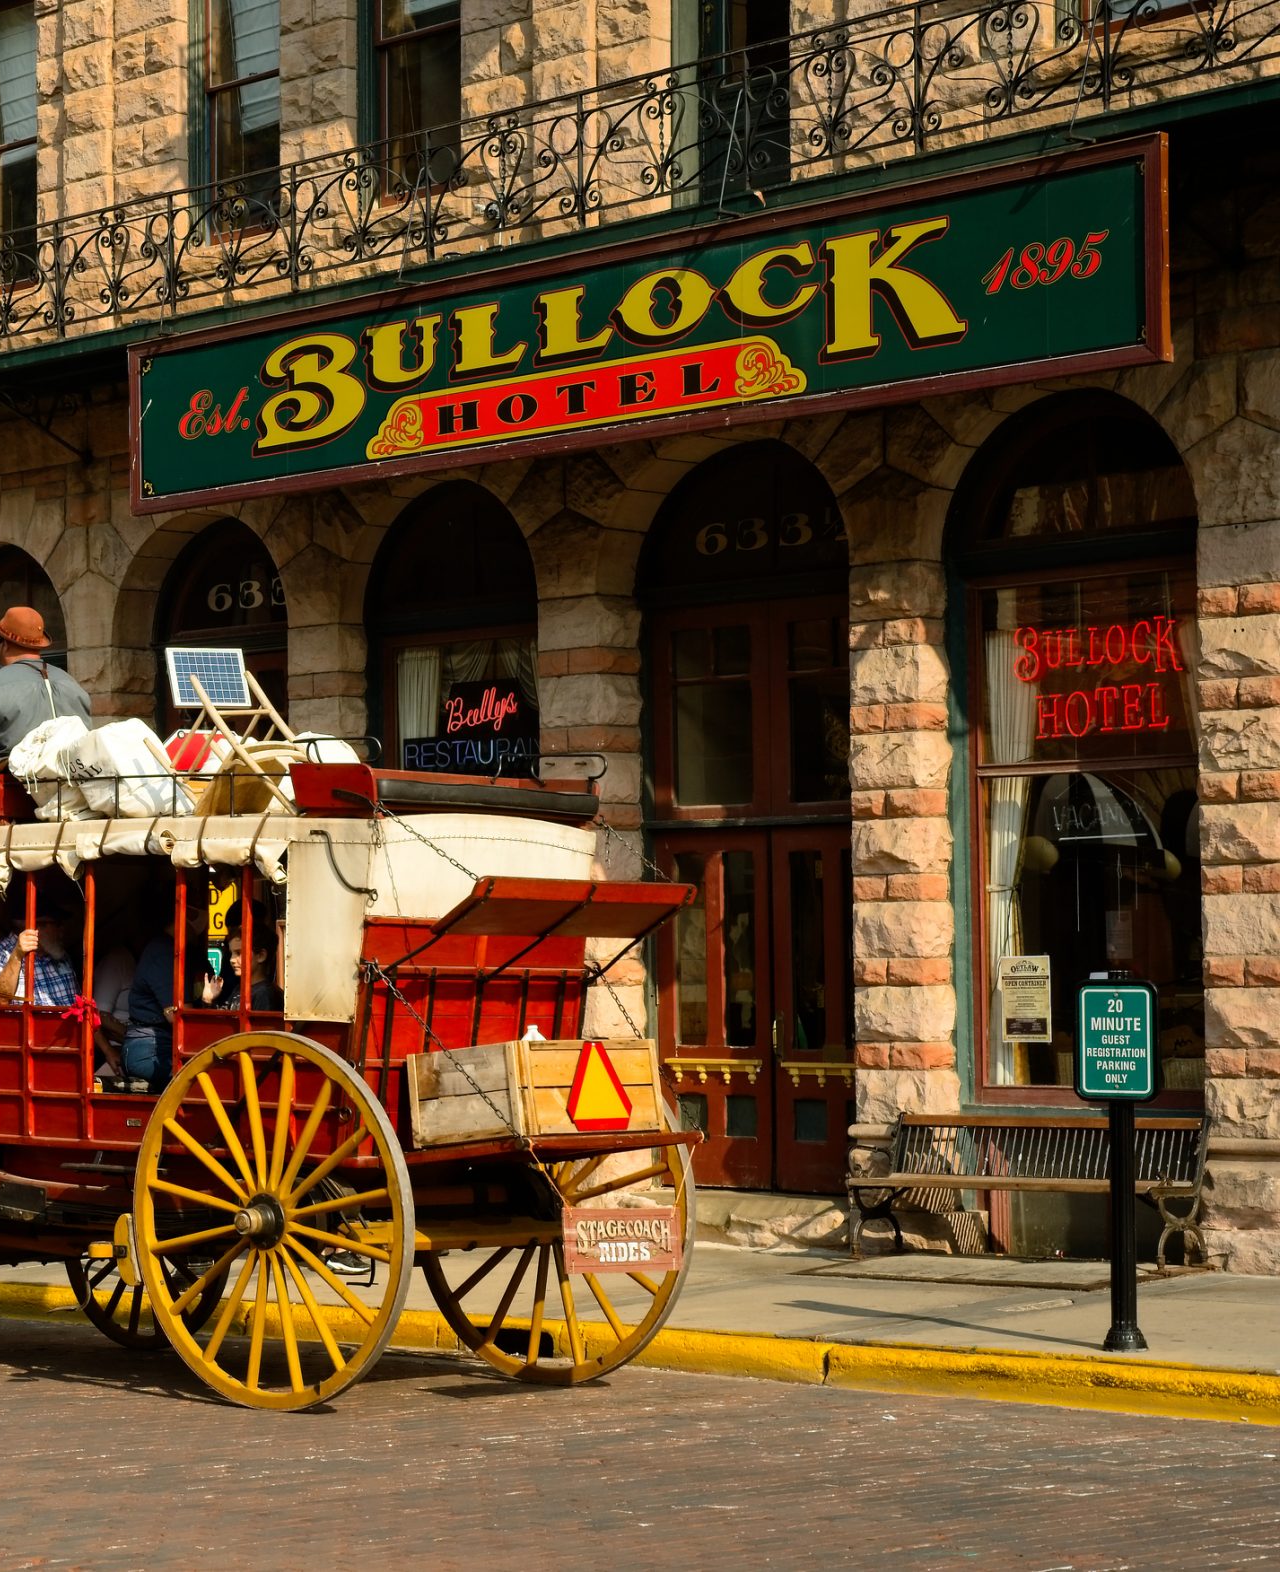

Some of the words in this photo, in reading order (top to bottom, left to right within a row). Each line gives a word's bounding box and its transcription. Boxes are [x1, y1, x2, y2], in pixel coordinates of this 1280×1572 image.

[179, 386, 251, 440] Est.
[252, 215, 969, 459] BULLOCK
[981, 229, 1110, 295] 1895
[435, 361, 722, 437] HOTEL
[1013, 616, 1184, 682] BULLOCK
[1034, 683, 1170, 740] HOTEL
[404, 736, 540, 769] RESTAURA
[1107, 999, 1124, 1013] 20
[1090, 1017, 1142, 1032] MINUTE
[1101, 1034, 1131, 1045] GUEST
[1086, 1047, 1147, 1058] REGISTRATION
[1096, 1061, 1136, 1071] PARKING
[1105, 1073, 1128, 1084] ONLY
[576, 1219, 673, 1255] STAGECOACH
[598, 1241, 652, 1263] RIDES
